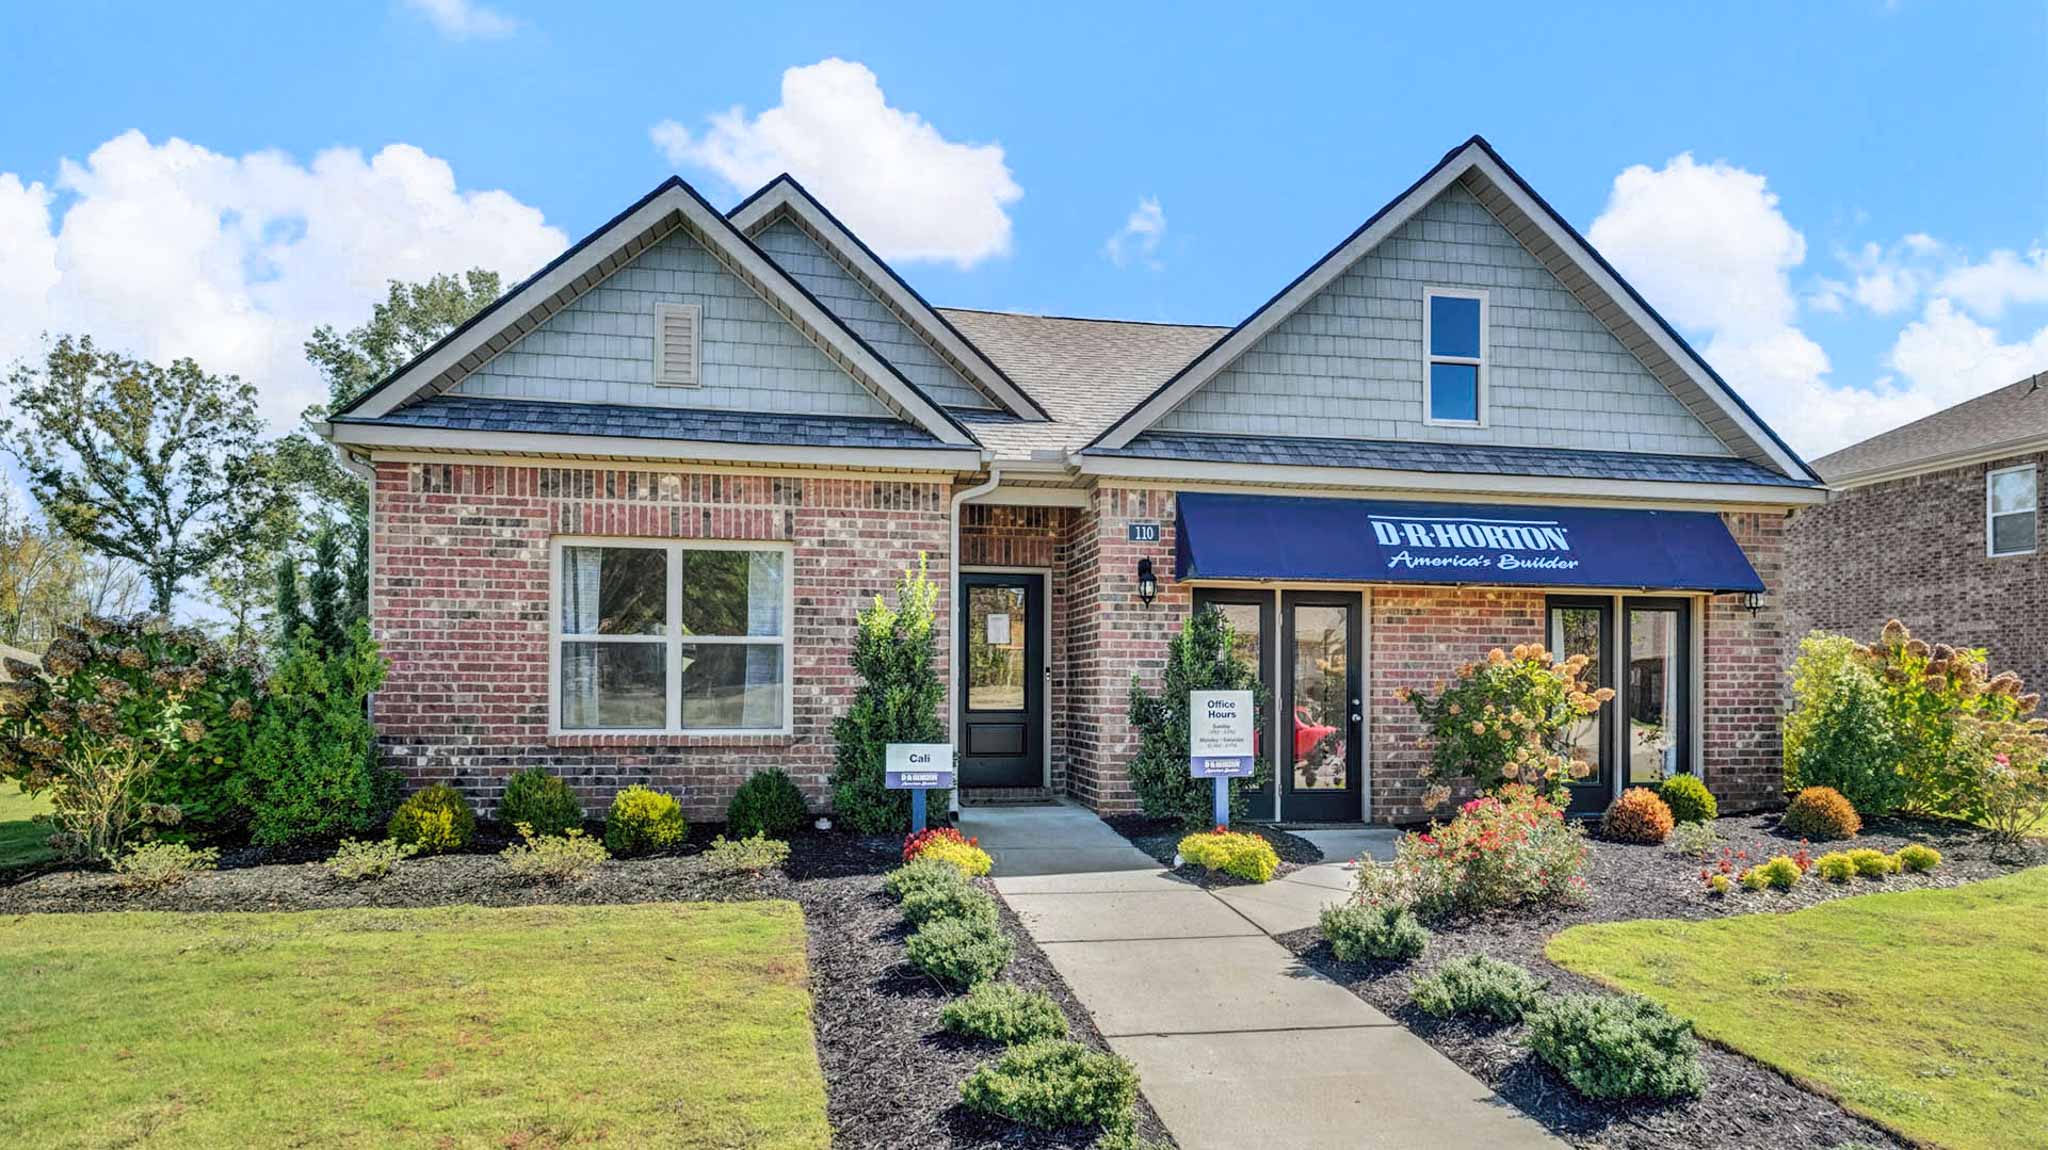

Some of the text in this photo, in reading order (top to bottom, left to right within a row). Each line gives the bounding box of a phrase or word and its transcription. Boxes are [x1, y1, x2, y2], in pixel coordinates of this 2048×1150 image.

[1135, 526, 1154, 540] 110
[1388, 551, 1579, 570] America's Builder
[1207, 700, 1236, 709] Office
[1208, 710, 1237, 719] Hours
[909, 753, 931, 763] Cali
